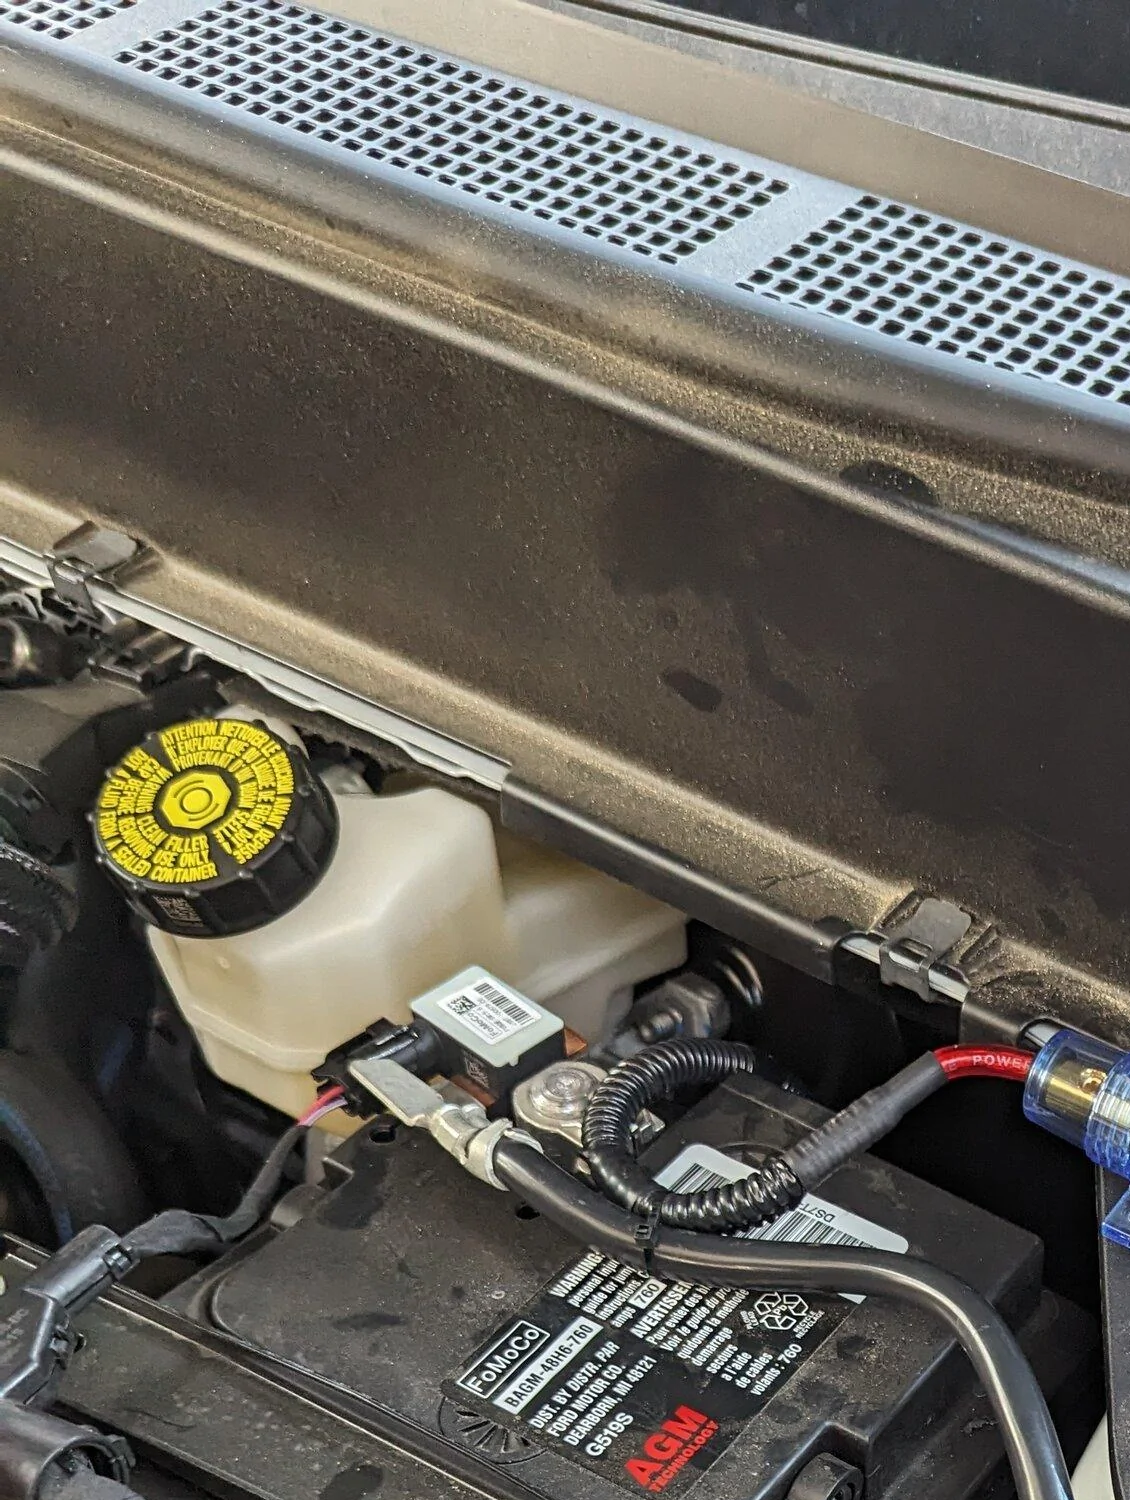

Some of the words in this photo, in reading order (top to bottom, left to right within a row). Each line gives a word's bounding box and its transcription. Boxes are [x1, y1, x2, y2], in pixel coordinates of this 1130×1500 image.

[159, 721, 218, 746] ATTENTION
[259, 739, 280, 757] LE
[101, 778, 126, 807] FLUID
[137, 766, 173, 813] WARNING
[257, 789, 274, 801] DE
[135, 757, 160, 778] CAP
[151, 849, 177, 866] USE
[177, 849, 210, 866] ONLY
[137, 814, 168, 845] CLEAN
[265, 796, 291, 828] AVANT
[111, 845, 152, 876] SEALED
[163, 835, 209, 851] FILLER
[149, 862, 217, 882] CONTAINER
[548, 1247, 605, 1297] WARNING:
[567, 1273, 603, 1307] personal
[581, 1291, 607, 1314] guide
[600, 1280, 618, 1293] for
[594, 1279, 643, 1320] instructions.
[609, 1306, 636, 1327] amps
[633, 1282, 660, 1303] 760
[772, 1304, 787, 1315] Pb
[645, 1325, 669, 1345] Pour
[664, 1305, 689, 1327] eviter
[683, 1293, 702, 1307] des
[659, 1334, 682, 1351] Voir
[675, 1325, 690, 1336] le
[685, 1306, 710, 1329] guide
[705, 1296, 719, 1308] du
[676, 1325, 713, 1359] quidonne
[705, 1317, 721, 1326] la
[715, 1288, 749, 1319] methode
[792, 1310, 816, 1332] RECYCLE
[465, 1328, 539, 1392] FoMoCo
[503, 1324, 593, 1407] BAGM-48H6-760
[690, 1326, 732, 1366] demarrage
[706, 1343, 738, 1373] secours
[724, 1352, 752, 1374] l'aide
[528, 1403, 560, 1428] DIST.
[551, 1388, 572, 1404] BY
[565, 1361, 601, 1391] DISTR.
[594, 1341, 619, 1362] PAR
[720, 1373, 732, 1381] a
[734, 1376, 751, 1388] de
[745, 1352, 773, 1377] cables
[750, 1367, 780, 1395] volants
[776, 1343, 802, 1363] 760
[545, 1409, 578, 1436] FORD
[570, 1377, 610, 1411] MOTOR
[601, 1364, 625, 1379] CO.
[562, 1395, 622, 1445] DEARBORN,
[612, 1380, 632, 1395] MI
[625, 1355, 656, 1382] 48121
[585, 1412, 633, 1455] G519S
[624, 1406, 707, 1485] AGM
[648, 1420, 718, 1491] TECHNOLOGY
